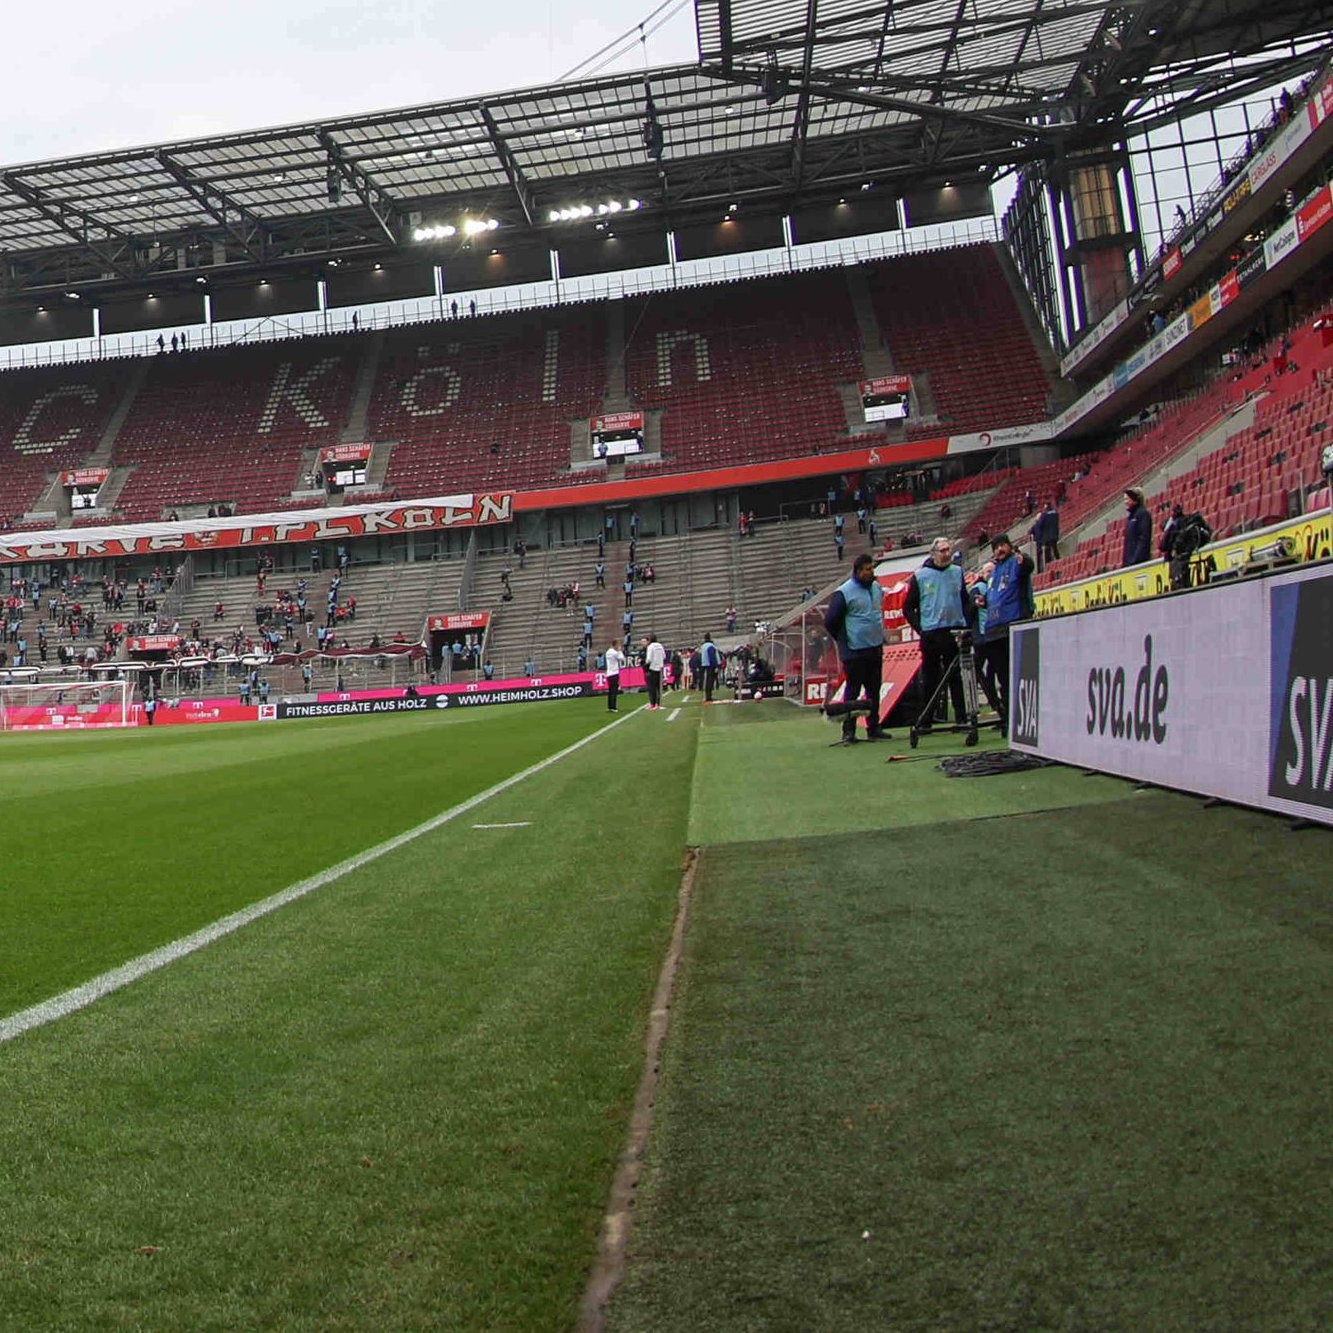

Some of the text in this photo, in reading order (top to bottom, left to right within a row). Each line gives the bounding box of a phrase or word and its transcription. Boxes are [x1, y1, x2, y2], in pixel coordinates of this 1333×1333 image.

[286, 698, 427, 716] FITNESSGERÄTE AUS HOLZ
[458, 686, 582, 706] WWW.HEIMHOLZ.SHOP
[1017, 678, 1038, 738] SVA
[1087, 634, 1169, 745] sva.de
